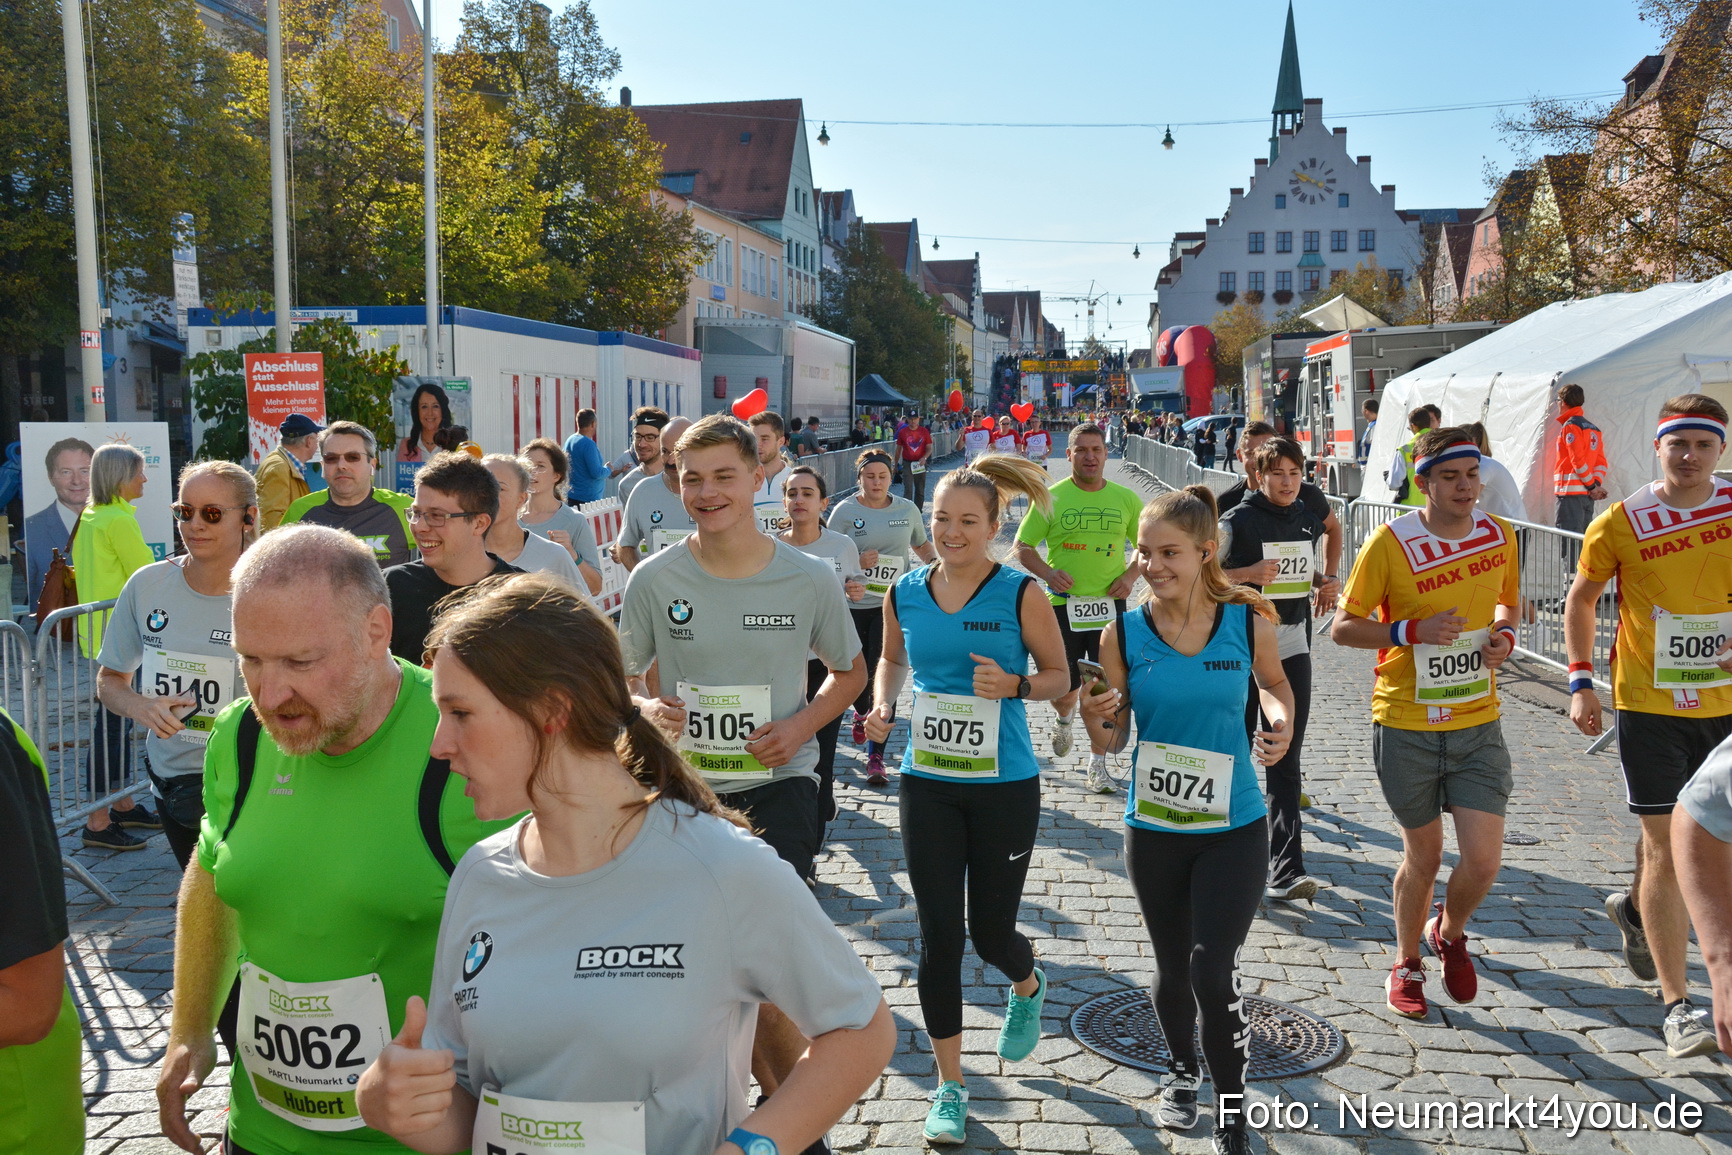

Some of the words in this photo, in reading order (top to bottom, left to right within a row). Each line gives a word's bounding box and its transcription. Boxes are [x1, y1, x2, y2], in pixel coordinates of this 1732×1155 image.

[120, 357, 128, 374] 3
[252, 361, 318, 373] Abschluss
[1046, 362, 1072, 370] START
[253, 381, 319, 392] Ausschluss!
[291, 406, 318, 414] Klassen.
[1062, 543, 1087, 551] MERZ
[1640, 535, 1694, 562] MAX
[865, 565, 897, 580] 5167
[1416, 567, 1464, 594] MAX
[1467, 552, 1506, 577] BÖGL
[1075, 602, 1109, 617] 5206
[744, 615, 796, 627] BOCK
[963, 621, 1001, 632] THULE
[1682, 621, 1718, 630] BOCK
[669, 628, 694, 636] PARTL
[142, 634, 163, 644] PARTL
[167, 658, 207, 672] BOCK
[1203, 660, 1241, 671] THULE
[1429, 650, 1481, 678] 5090
[1451, 676, 1473, 684] Neumarkt
[1681, 671, 1715, 682] Florian
[1442, 686, 1470, 698] Julian
[699, 695, 742, 706] BOCK
[937, 701, 974, 713] BOCK
[688, 711, 755, 741] 5105
[924, 716, 984, 746] 5075
[694, 743, 712, 751] PARTL
[946, 746, 972, 754] Neumarkt
[700, 756, 743, 769] Bastian
[934, 755, 972, 770] Hannah
[1165, 752, 1207, 769] BOCK
[1149, 766, 1215, 804] 5074
[269, 788, 293, 796] erima
[1153, 795, 1172, 806] PARTL
[1173, 800, 1200, 812] Neumarkt
[1166, 810, 1194, 823] Alina
[576, 943, 685, 970] BOCK
[574, 971, 605, 980] inspired
[607, 970, 618, 979] by
[619, 970, 644, 978] smart
[646, 971, 685, 980] concepts
[269, 988, 332, 1013] BOCK
[454, 986, 479, 1005] PARTL
[254, 1014, 366, 1070] 5062
[268, 1067, 295, 1083] PARTL
[296, 1075, 343, 1086] Neumarkt
[284, 1090, 345, 1115] Hubert
[501, 1112, 584, 1140] BOCK
[502, 1133, 524, 1143] inspired
[524, 1136, 532, 1146] by
[553, 1141, 586, 1149] concepts
